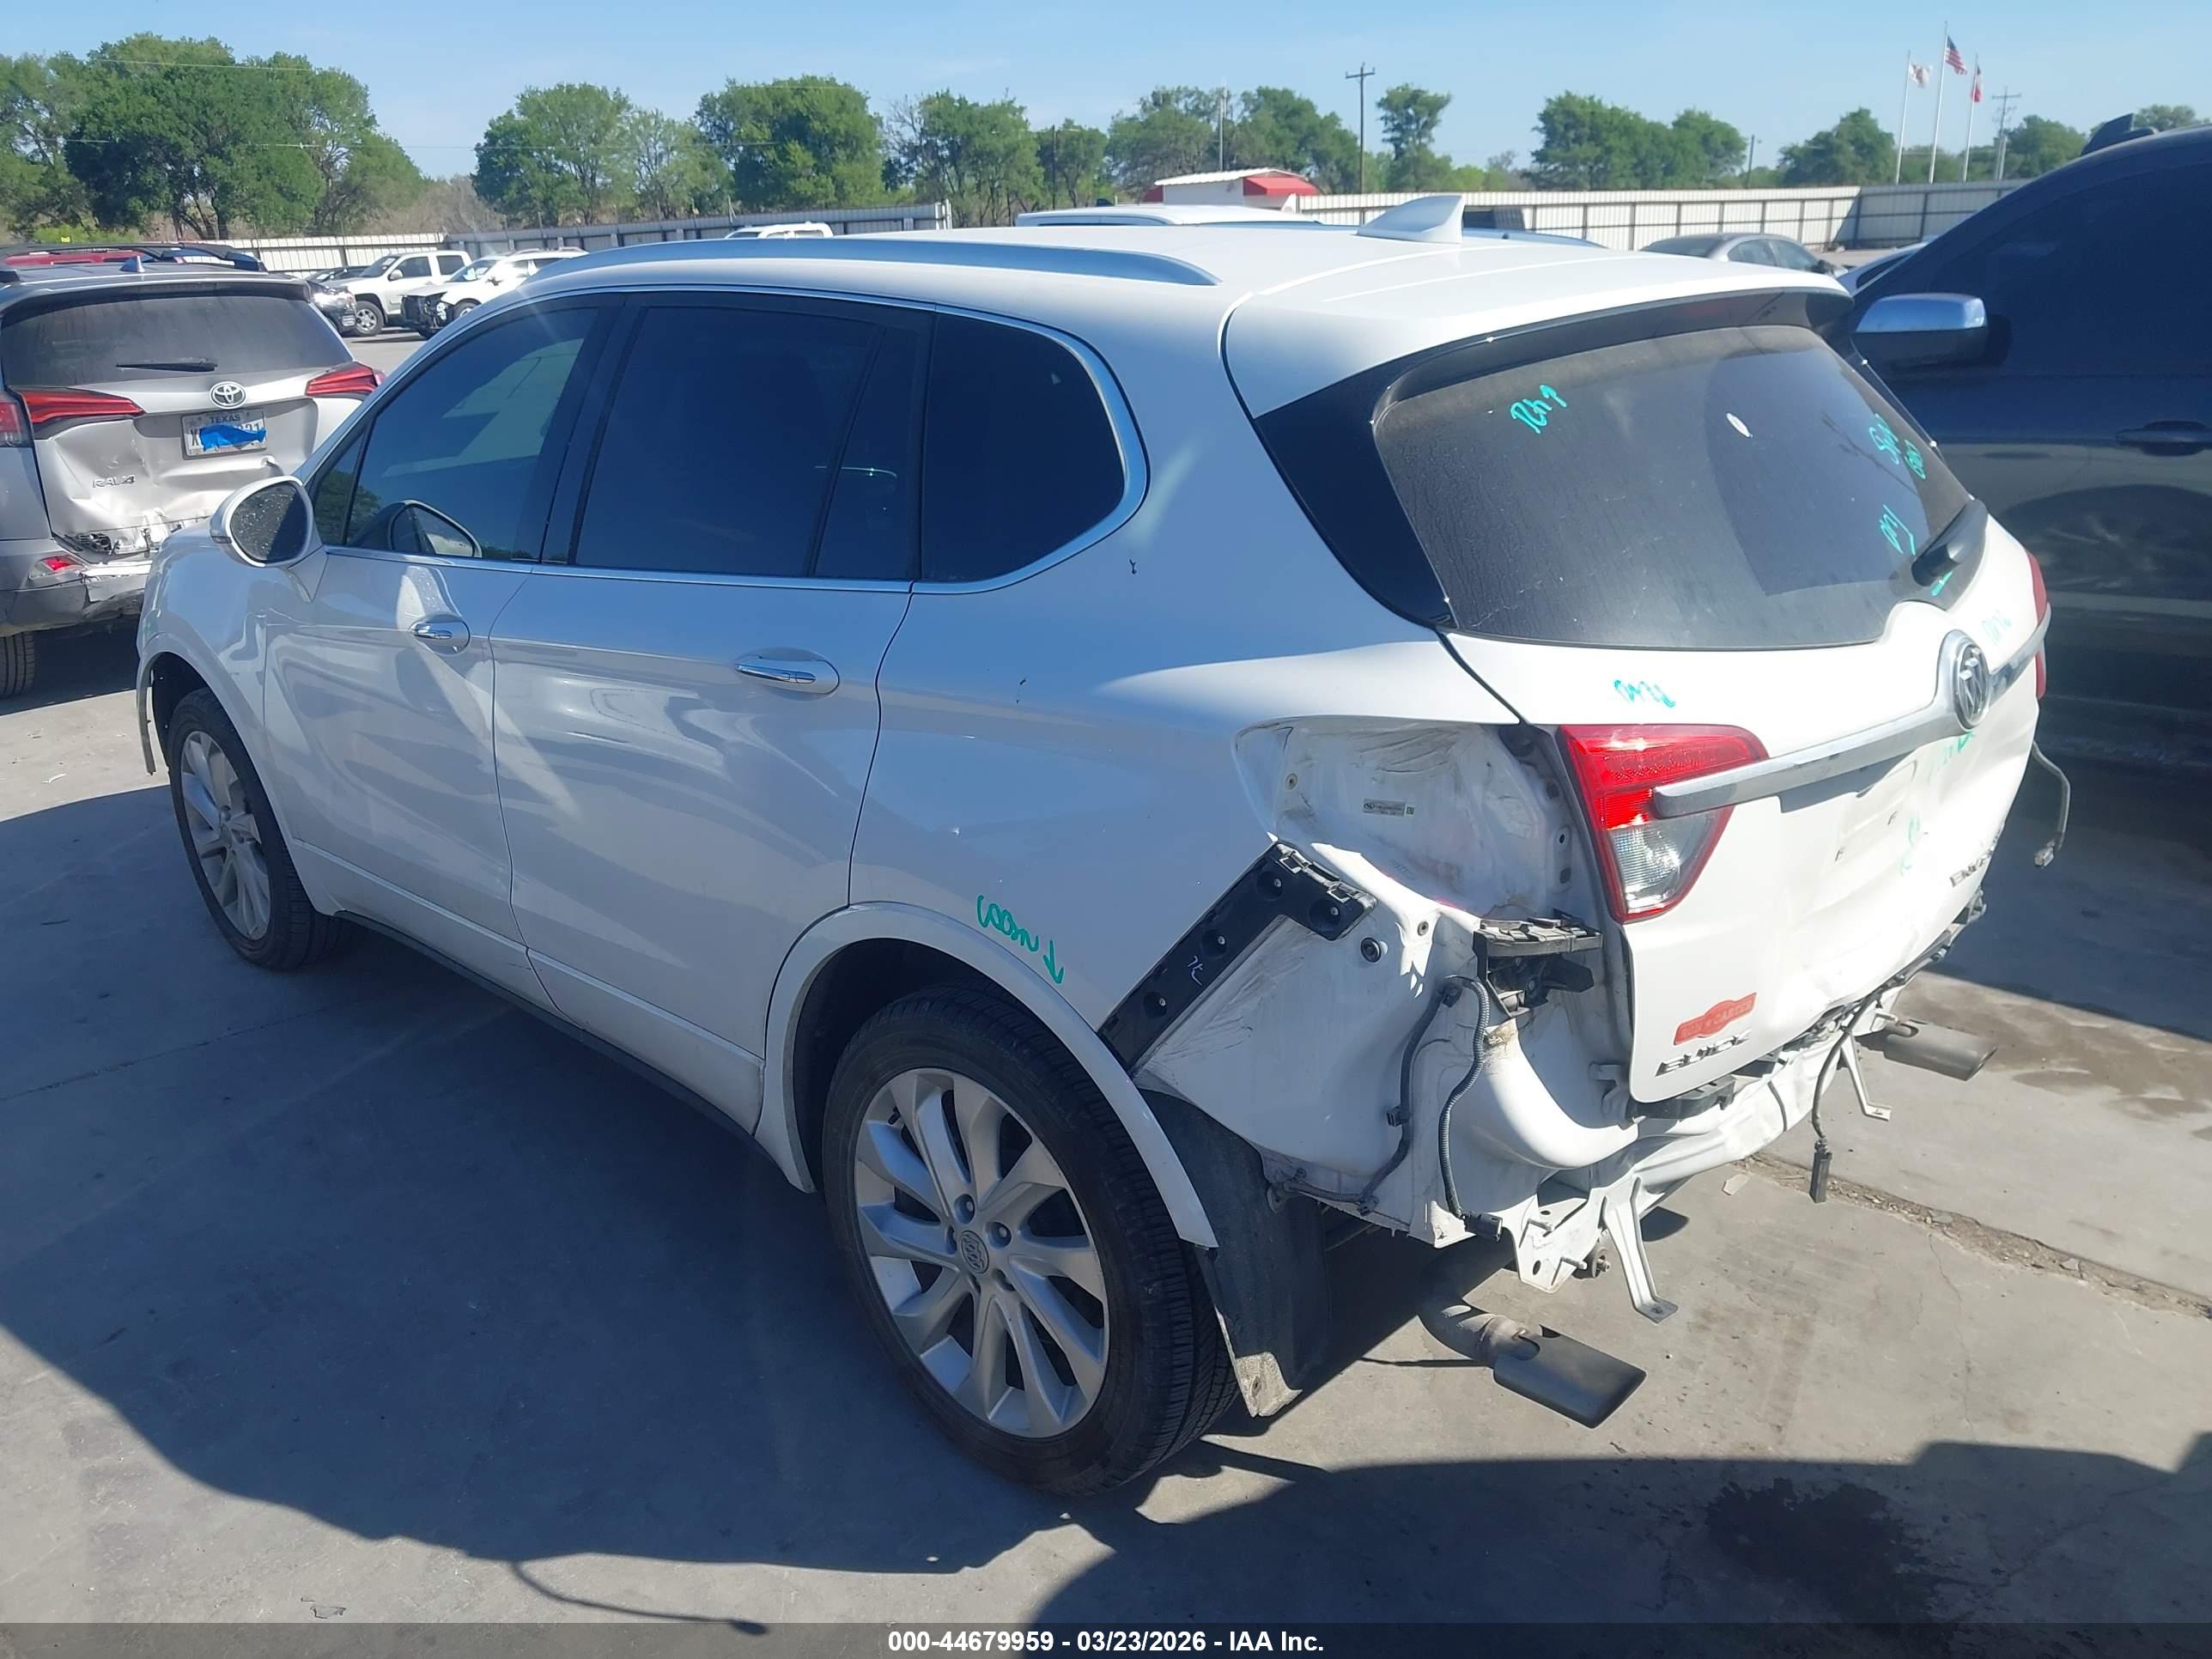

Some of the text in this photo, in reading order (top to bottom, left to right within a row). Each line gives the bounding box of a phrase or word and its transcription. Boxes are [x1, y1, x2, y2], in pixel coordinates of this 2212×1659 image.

[210, 413, 241, 424] TEXAS
[92, 474, 137, 489] RAV4
[1654, 1028, 1752, 1078] BUICK
